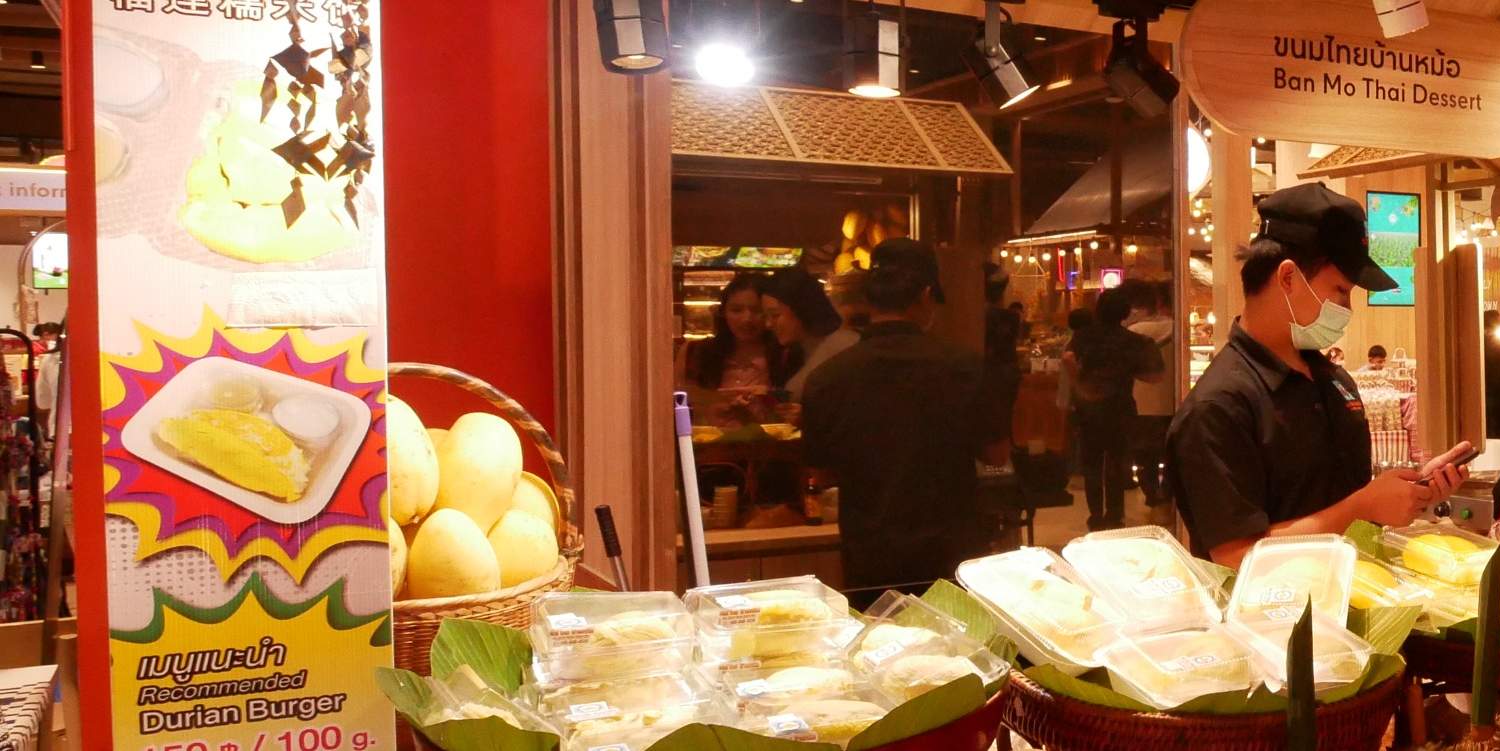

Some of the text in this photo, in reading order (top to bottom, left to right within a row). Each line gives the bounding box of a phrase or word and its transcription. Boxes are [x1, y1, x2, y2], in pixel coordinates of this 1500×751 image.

[1273, 35, 1461, 78] ขนมไทยบ้านหม้อ
[1274, 67, 1483, 111] Ban Mo Thai Dessert
[139, 637, 286, 682] เมนูแนะนำ
[139, 669, 307, 705] Recommended
[141, 693, 346, 734] Durian Burger
[278, 726, 342, 751] 100
[352, 730, 376, 751] g.
